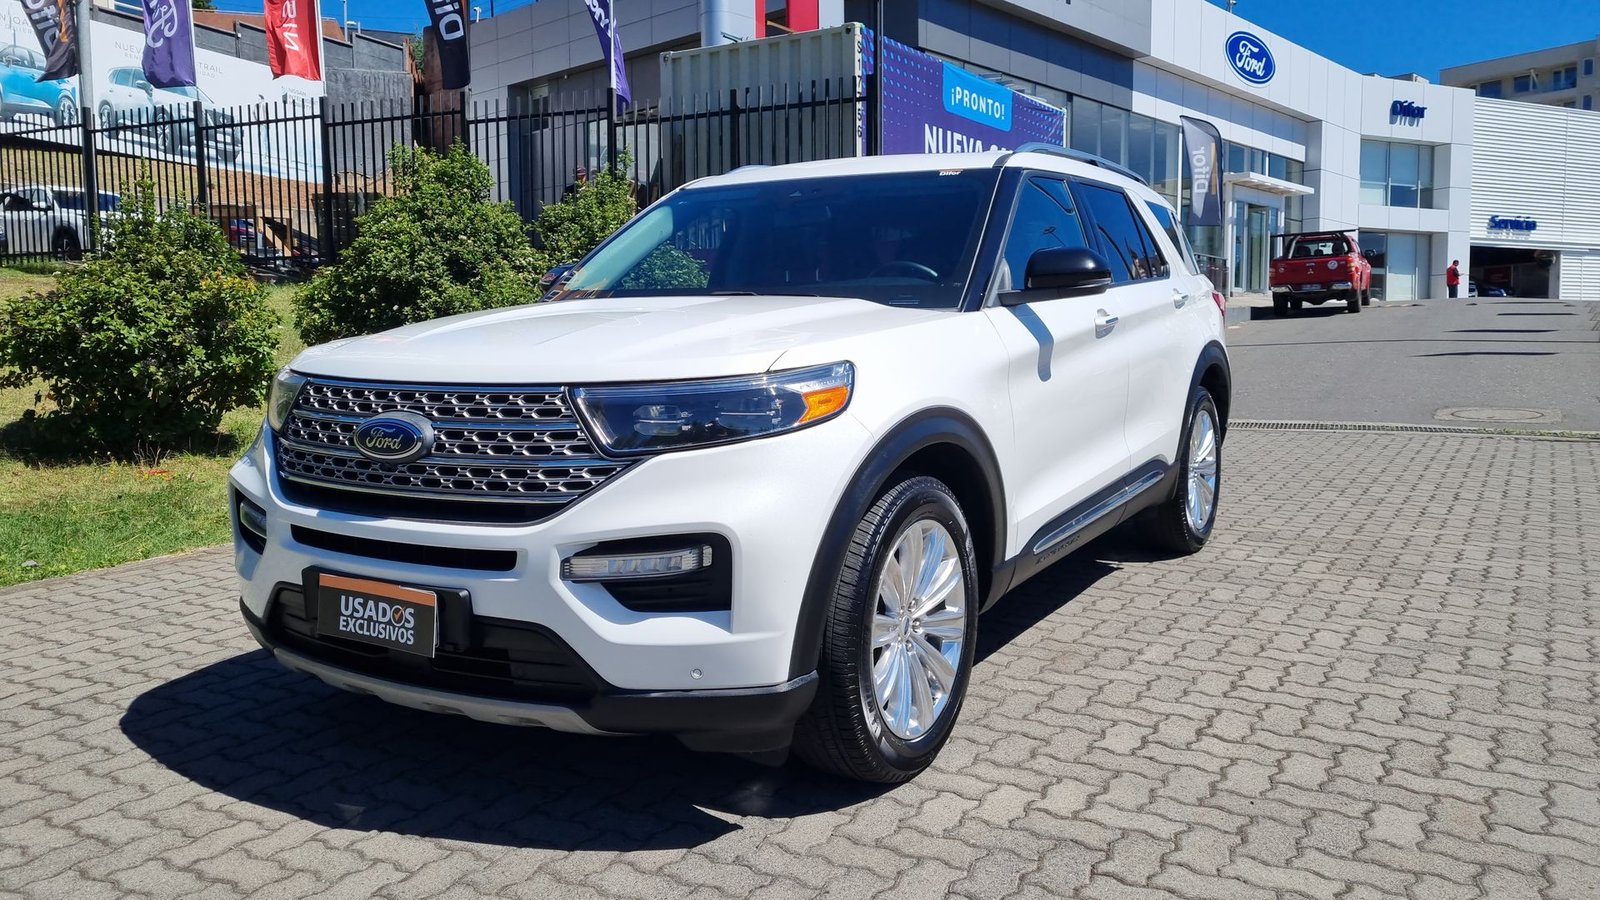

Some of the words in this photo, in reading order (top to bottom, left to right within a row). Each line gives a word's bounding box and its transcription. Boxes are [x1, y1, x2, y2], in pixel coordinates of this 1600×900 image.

[1236, 40, 1267, 77] Ford
[951, 86, 1005, 120] ¡PRONTO!
[1390, 100, 1427, 119] Difor
[1488, 214, 1537, 231] Servicio
[366, 427, 403, 449] Ford
[340, 595, 415, 629] USADOS
[339, 615, 415, 645] EXCLUSIVOS
